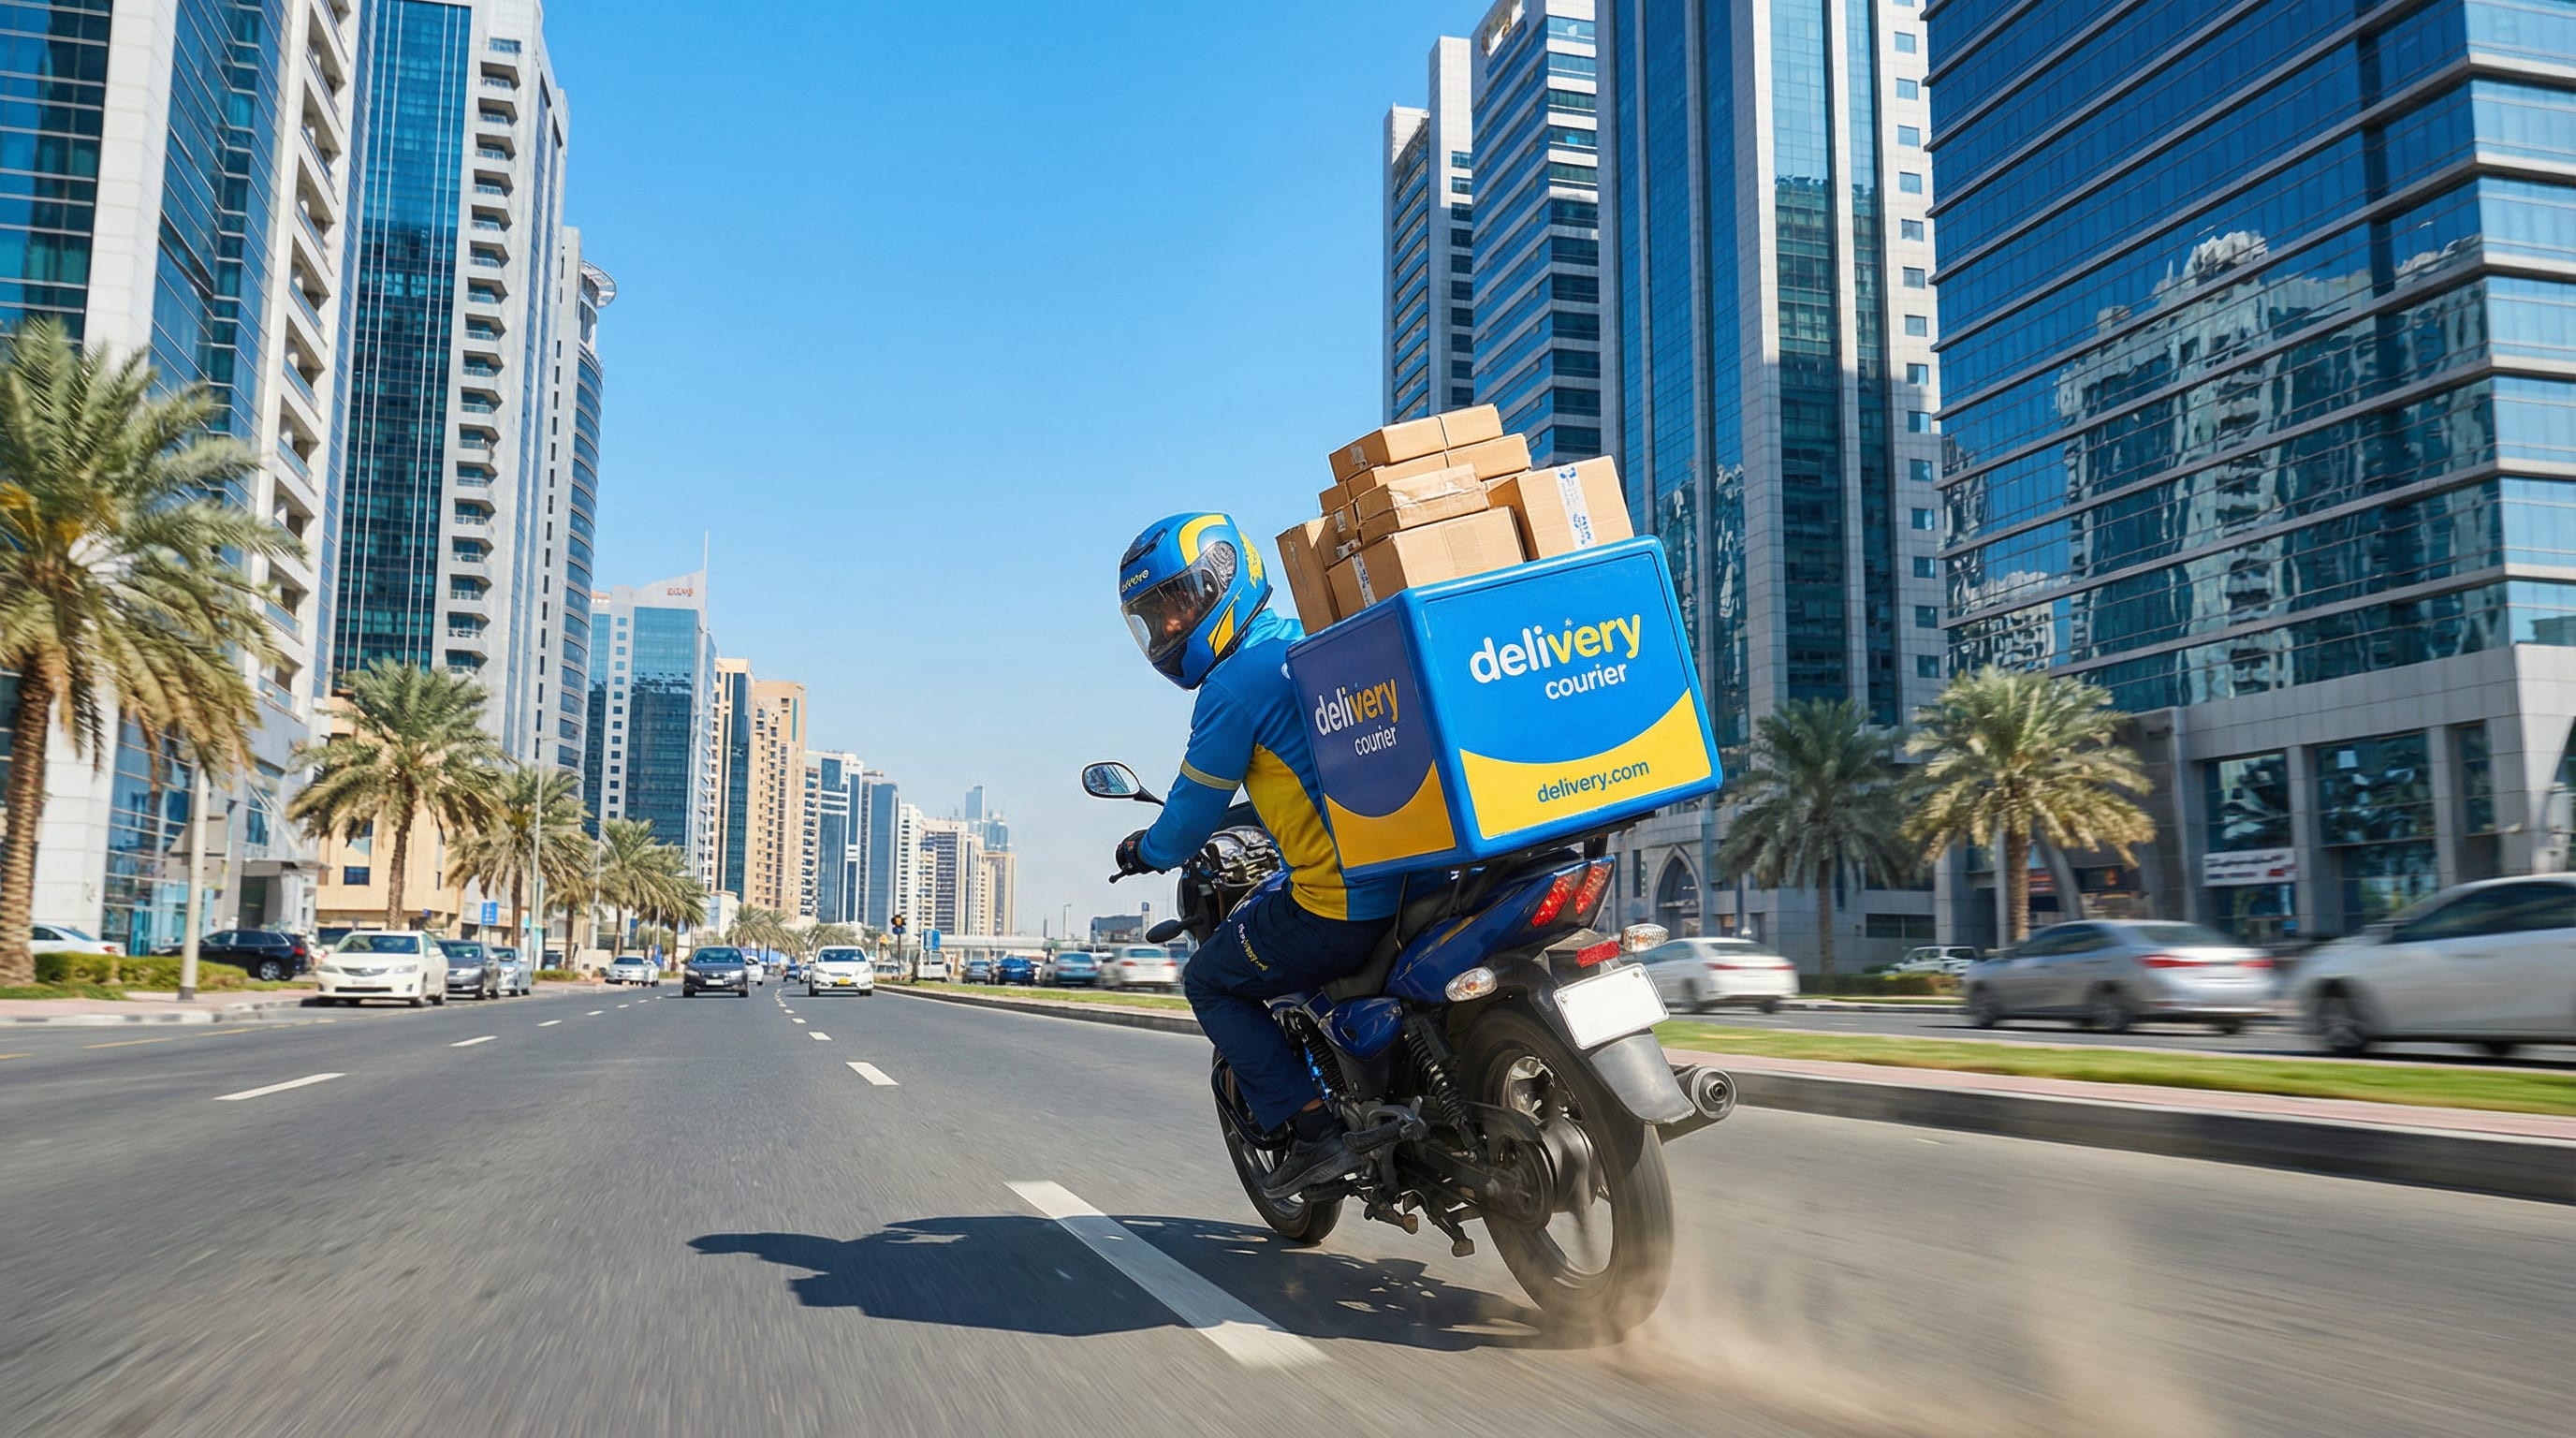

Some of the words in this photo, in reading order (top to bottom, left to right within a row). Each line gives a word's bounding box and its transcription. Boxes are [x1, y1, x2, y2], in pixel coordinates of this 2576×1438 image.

[1469, 614, 1641, 683] delivery
[1545, 663, 1627, 700] courier
[1315, 678, 1398, 736] delivery
[1354, 724, 1397, 756] courier
[1537, 761, 1649, 803] delivery.com
